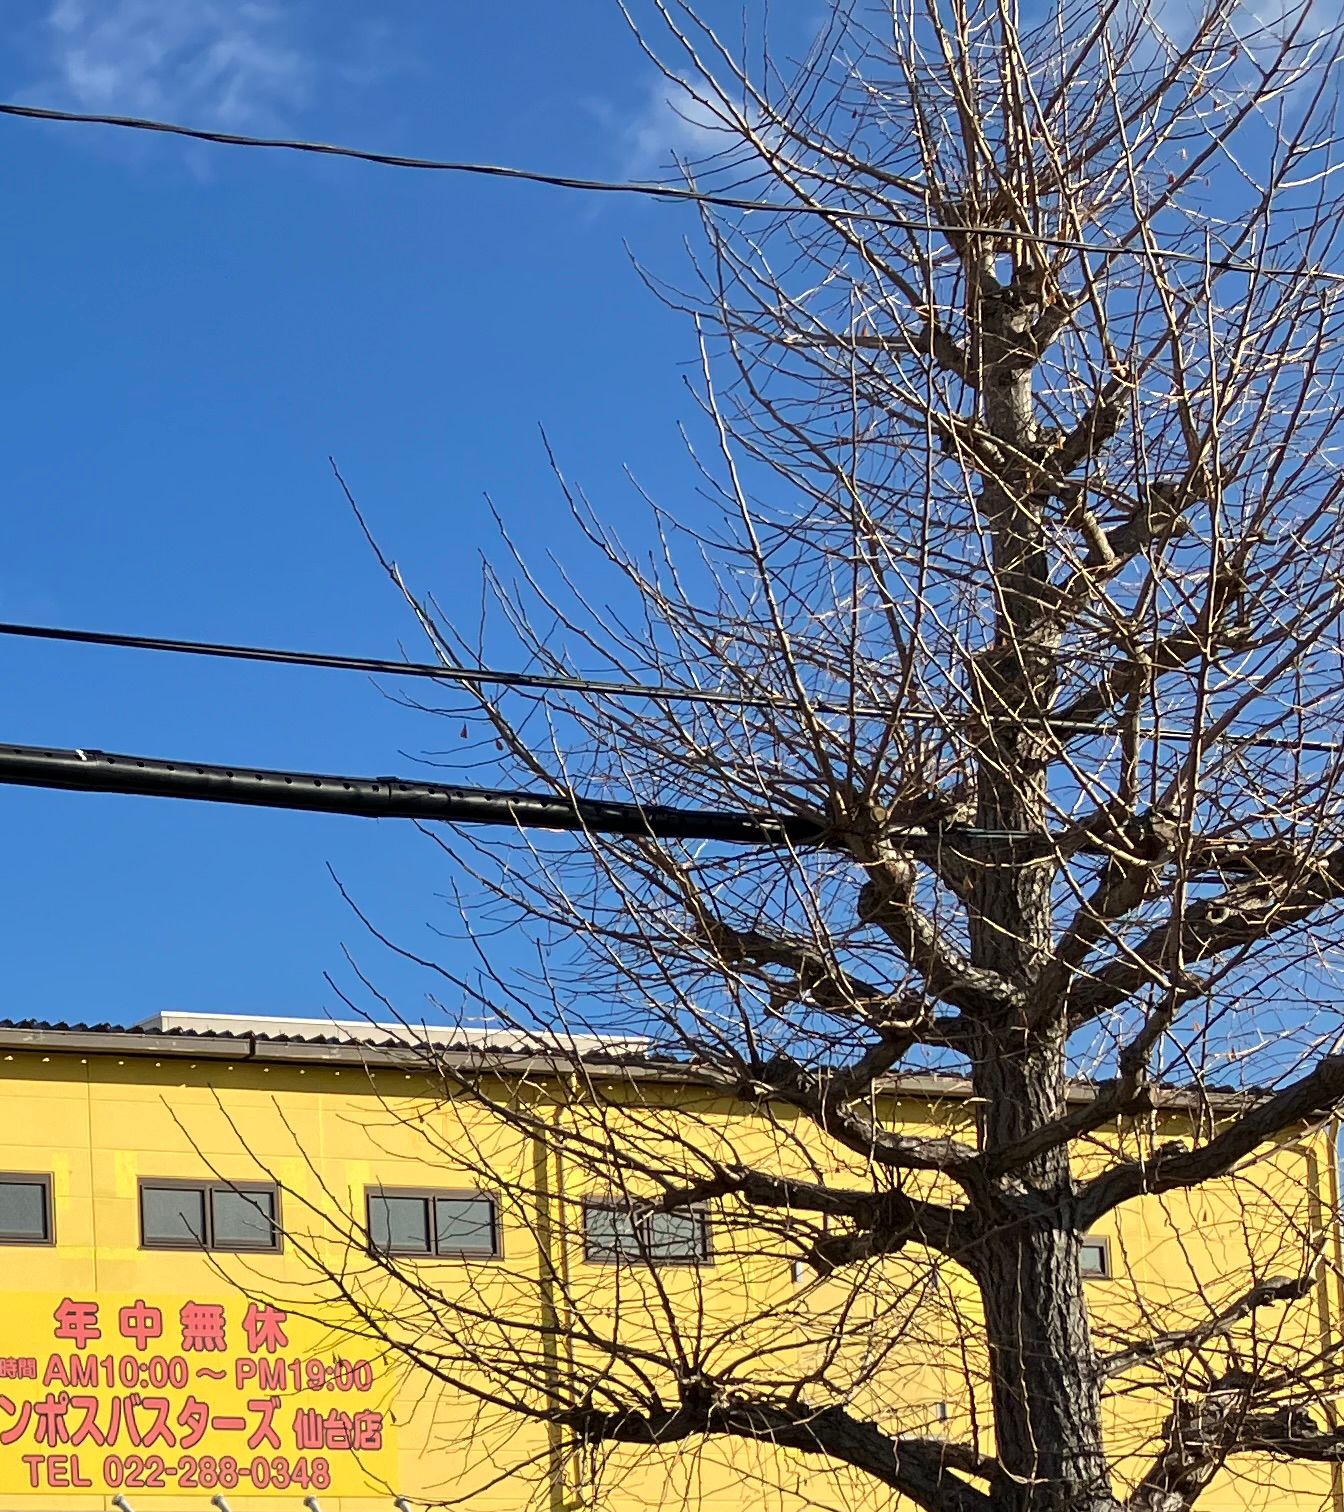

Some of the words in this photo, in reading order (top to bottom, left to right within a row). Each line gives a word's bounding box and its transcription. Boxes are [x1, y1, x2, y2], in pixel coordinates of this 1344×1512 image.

[53, 1297, 290, 1354] 年中無休
[42, 1353, 189, 1390] AM10:00
[234, 1357, 374, 1393] PM19:00
[291, 1407, 385, 1452] 仙台店
[21, 1454, 93, 1488] TEL
[102, 1454, 332, 1491] 022-288-0348
